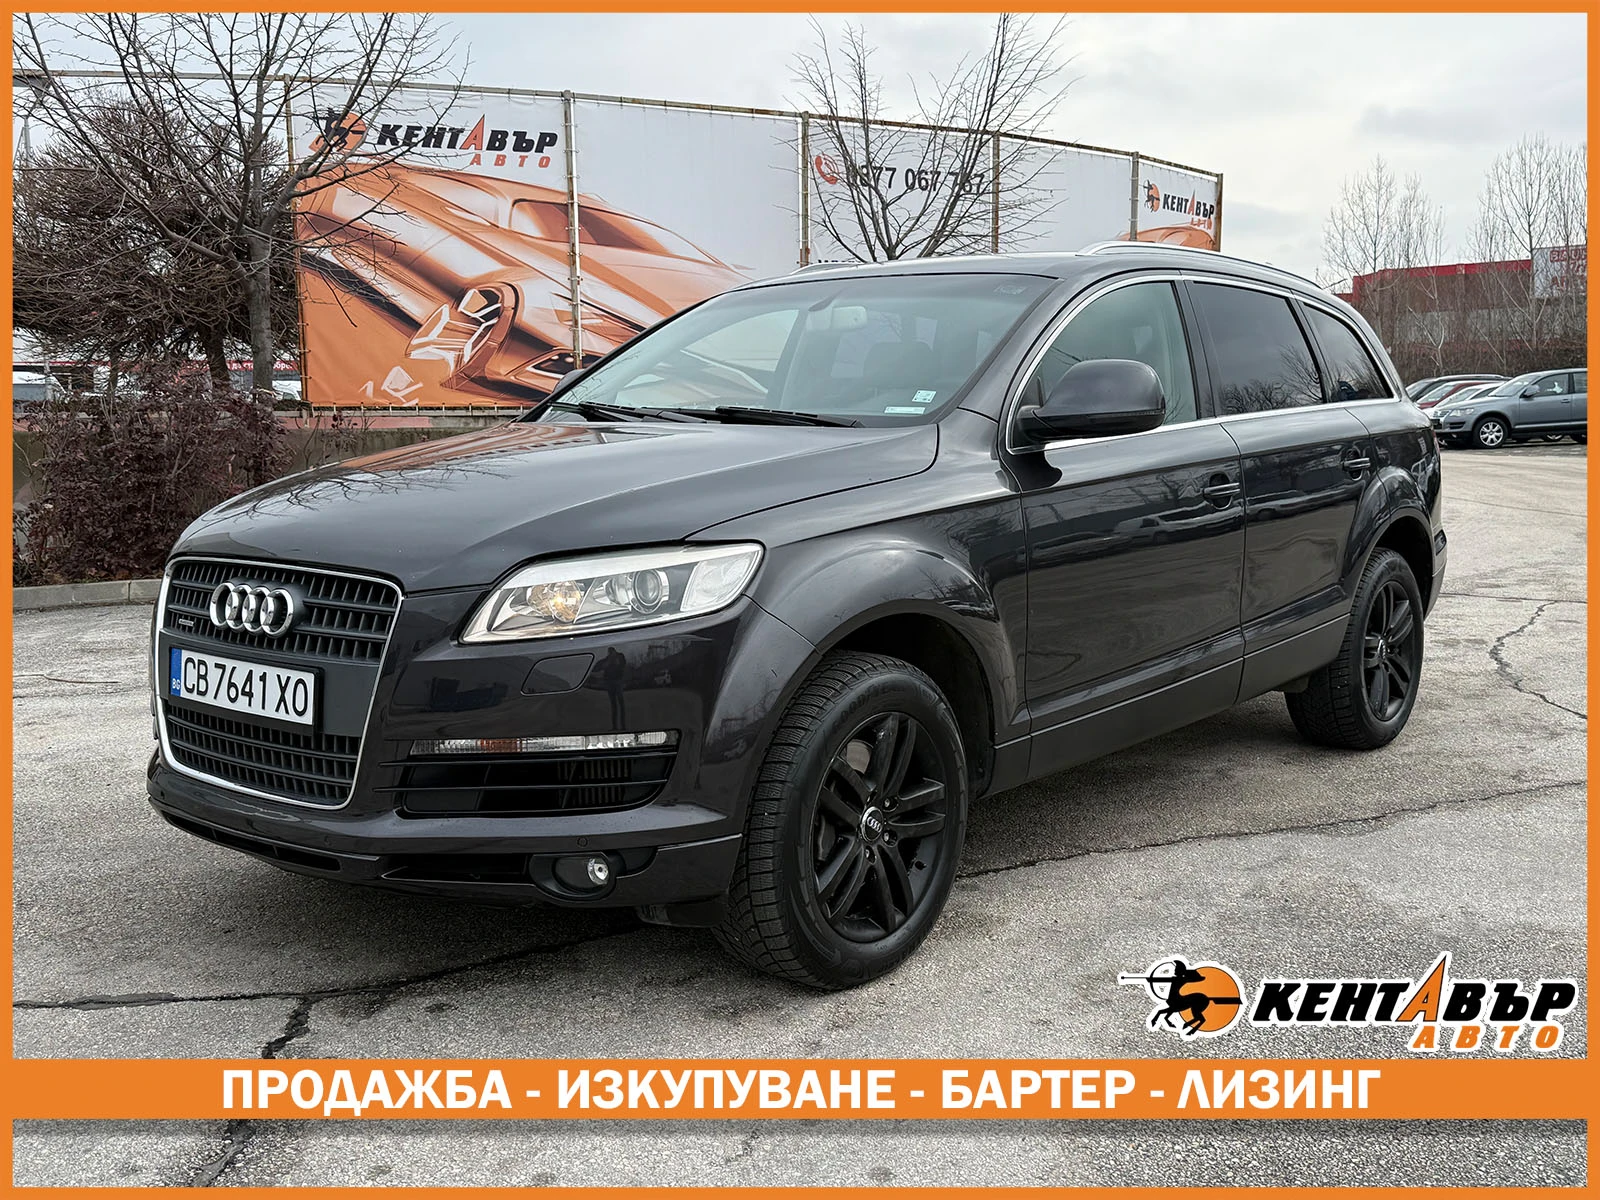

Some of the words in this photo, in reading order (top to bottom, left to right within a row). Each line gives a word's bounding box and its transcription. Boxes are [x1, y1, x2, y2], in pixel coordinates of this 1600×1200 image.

[377, 114, 558, 153] КЕНТАВЪР
[470, 153, 551, 168] АВТО
[849, 165, 897, 188] 877
[904, 168, 941, 191] 067
[1162, 189, 1214, 219] КЕНТАВЪР
